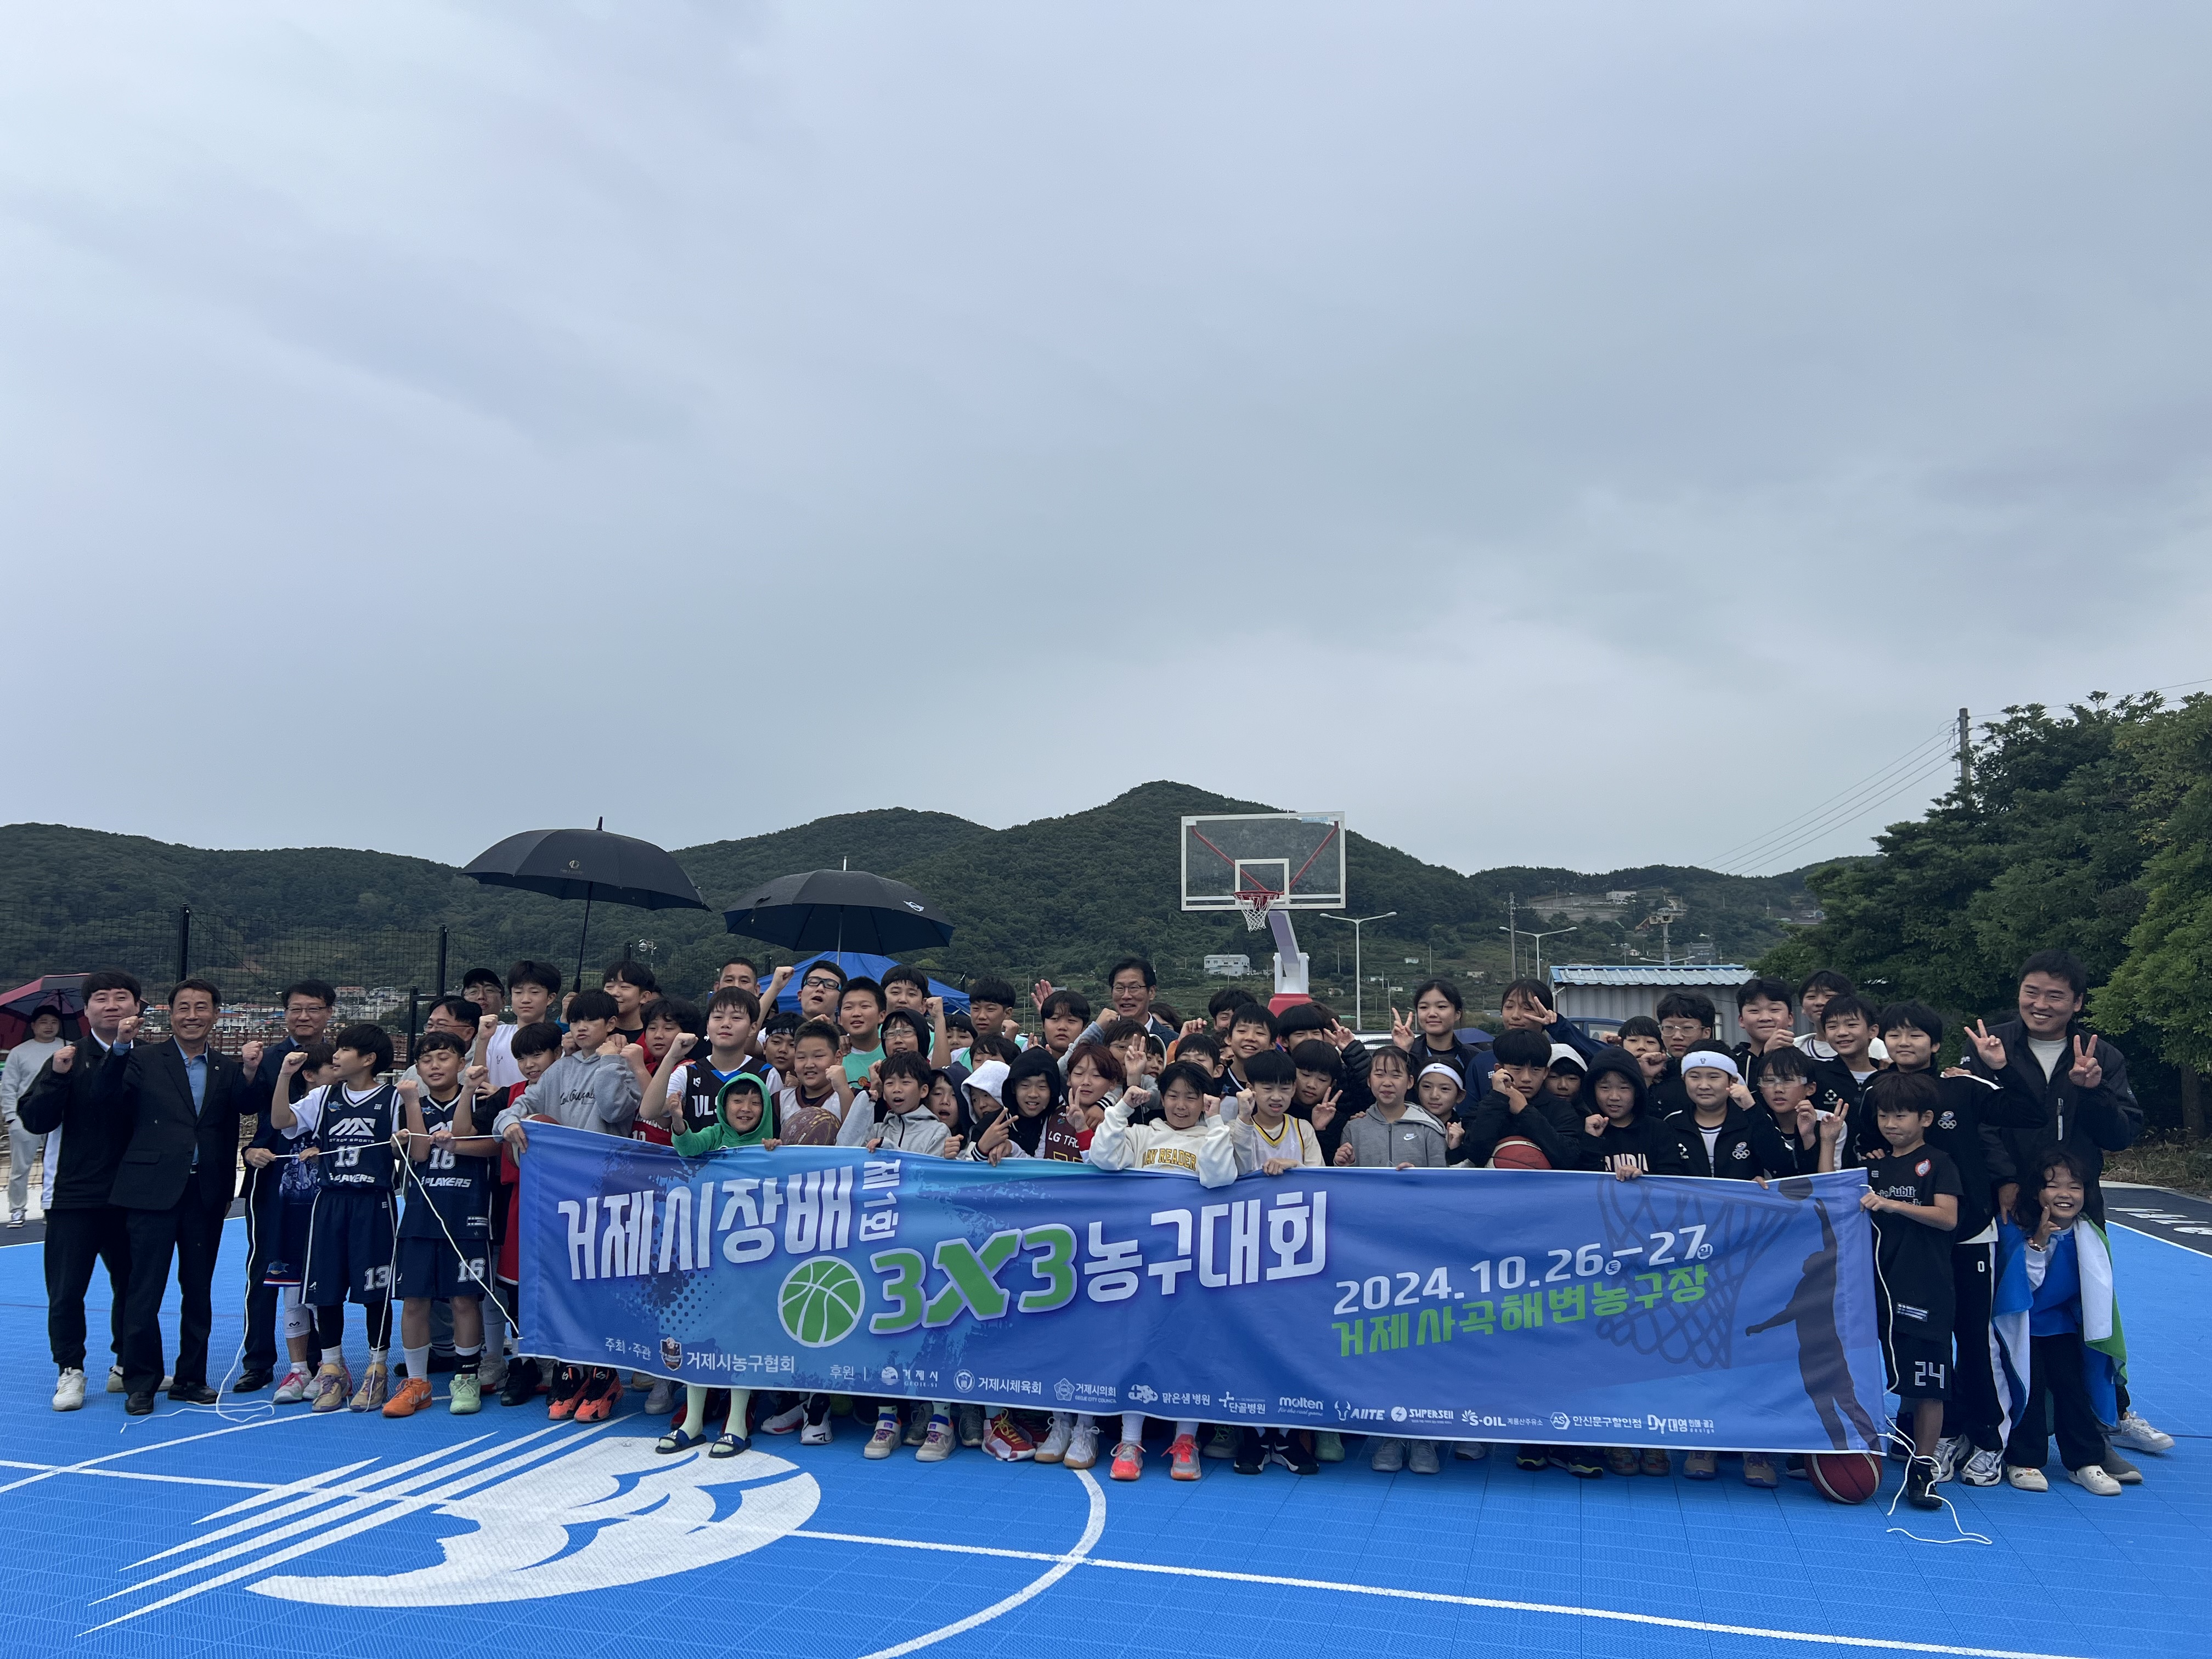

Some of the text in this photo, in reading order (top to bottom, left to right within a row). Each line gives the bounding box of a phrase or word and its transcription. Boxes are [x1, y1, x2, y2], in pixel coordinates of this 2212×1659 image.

[1048, 1131, 1062, 1142] LG
[334, 1145, 362, 1167] 13
[429, 1147, 456, 1170] 16
[1158, 1148, 1197, 1171] READER
[425, 1177, 472, 1188] PLAYERS
[557, 1165, 854, 1280] 거제시장배
[1084, 1190, 1327, 1303] 농구대회
[364, 1265, 391, 1291] 13
[458, 1257, 486, 1283] 16
[686, 1351, 795, 1374] 거제시농구협회
[830, 1364, 854, 1380] 후원
[1915, 1361, 1944, 1389] 24
[978, 1377, 1042, 1395] 거제시체육회
[1075, 1383, 1116, 1397] 거제시의회
[1279, 1397, 1323, 1410] molten
[1469, 1414, 1506, 1426] S-OIL
[1553, 1416, 1566, 1425] AS
[1647, 1414, 1667, 1435] DY
[1668, 1418, 1688, 1432] 대영
